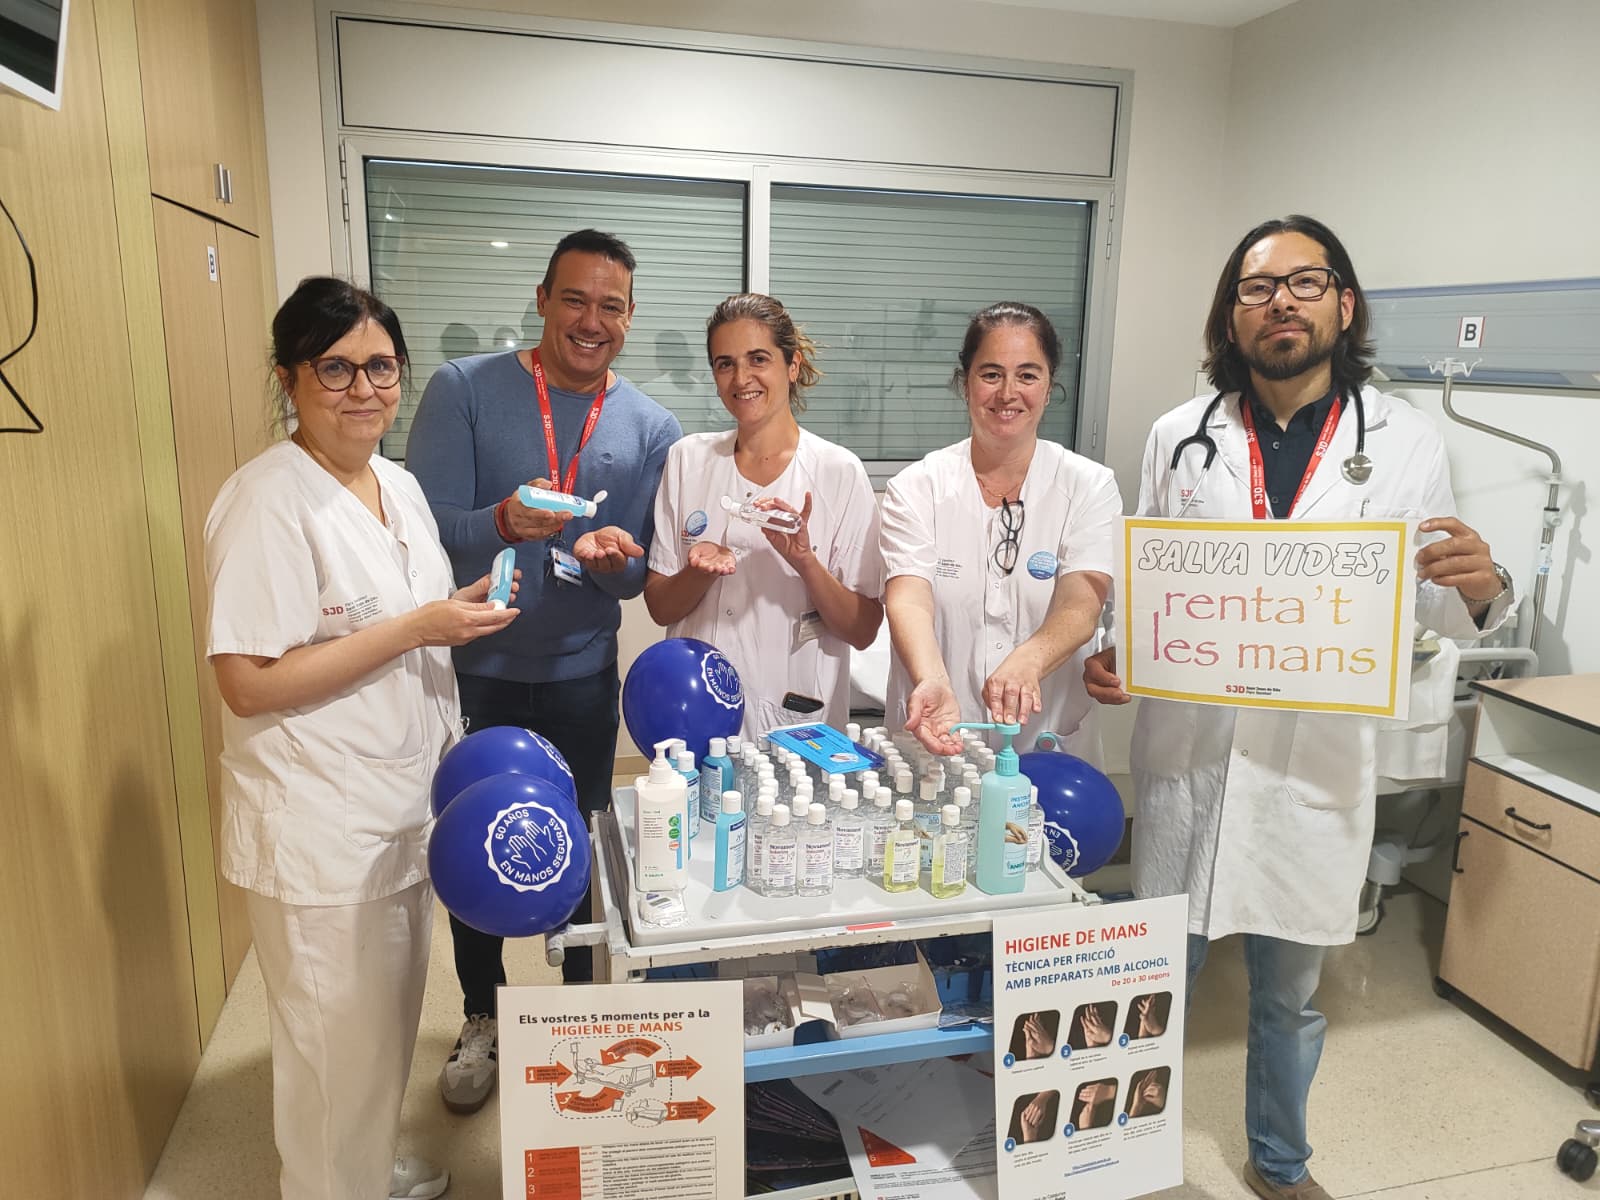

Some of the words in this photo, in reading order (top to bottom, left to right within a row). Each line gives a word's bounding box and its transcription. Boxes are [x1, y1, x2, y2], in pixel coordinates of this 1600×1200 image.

[1464, 323, 1477, 341] B
[544, 414, 552, 429] SJD
[1254, 487, 1264, 505] SJD
[1138, 539, 1249, 576] SALVA
[1265, 543, 1390, 584] VIDES,
[322, 606, 344, 616] SJD
[1153, 611, 1220, 666] les
[1238, 642, 1377, 674] mans
[1226, 684, 1245, 694] SJD
[495, 826, 506, 840] 60
[500, 860, 515, 876] EN
[514, 868, 554, 883] MANOS
[548, 818, 565, 869] SEGURAS
[1005, 932, 1070, 954] HIGIENE
[1076, 930, 1096, 945] DE
[1101, 922, 1148, 942] MANS
[1006, 958, 1050, 973] TÈCNICA
[1053, 954, 1073, 968] PER
[1076, 946, 1116, 964] FRICCIÓ
[1005, 977, 1031, 991] AMB
[1034, 968, 1094, 986] PREPARATS
[1097, 964, 1120, 977] AMB
[1123, 956, 1169, 972] ALCOHOL
[1112, 978, 1121, 987] De
[1122, 976, 1132, 986] 20
[1138, 974, 1147, 983] 30
[1149, 972, 1170, 982] segons
[519, 1014, 538, 1024] Els
[541, 1013, 588, 1024] vostres
[590, 1014, 598, 1024] 5
[602, 1011, 660, 1022] moments
[663, 1010, 685, 1021] per
[698, 1008, 710, 1018] la
[551, 1024, 612, 1036] HIGIENE
[616, 1023, 636, 1034] DE
[640, 1021, 683, 1033] MANS
[607, 1051, 620, 1060] 2
[528, 1069, 536, 1080] 1
[658, 1064, 666, 1076] 4
[559, 1093, 572, 1105] 3
[670, 1106, 678, 1117] 5
[527, 1153, 534, 1162] 1
[527, 1167, 535, 1178] 2
[528, 1184, 536, 1194] 3
